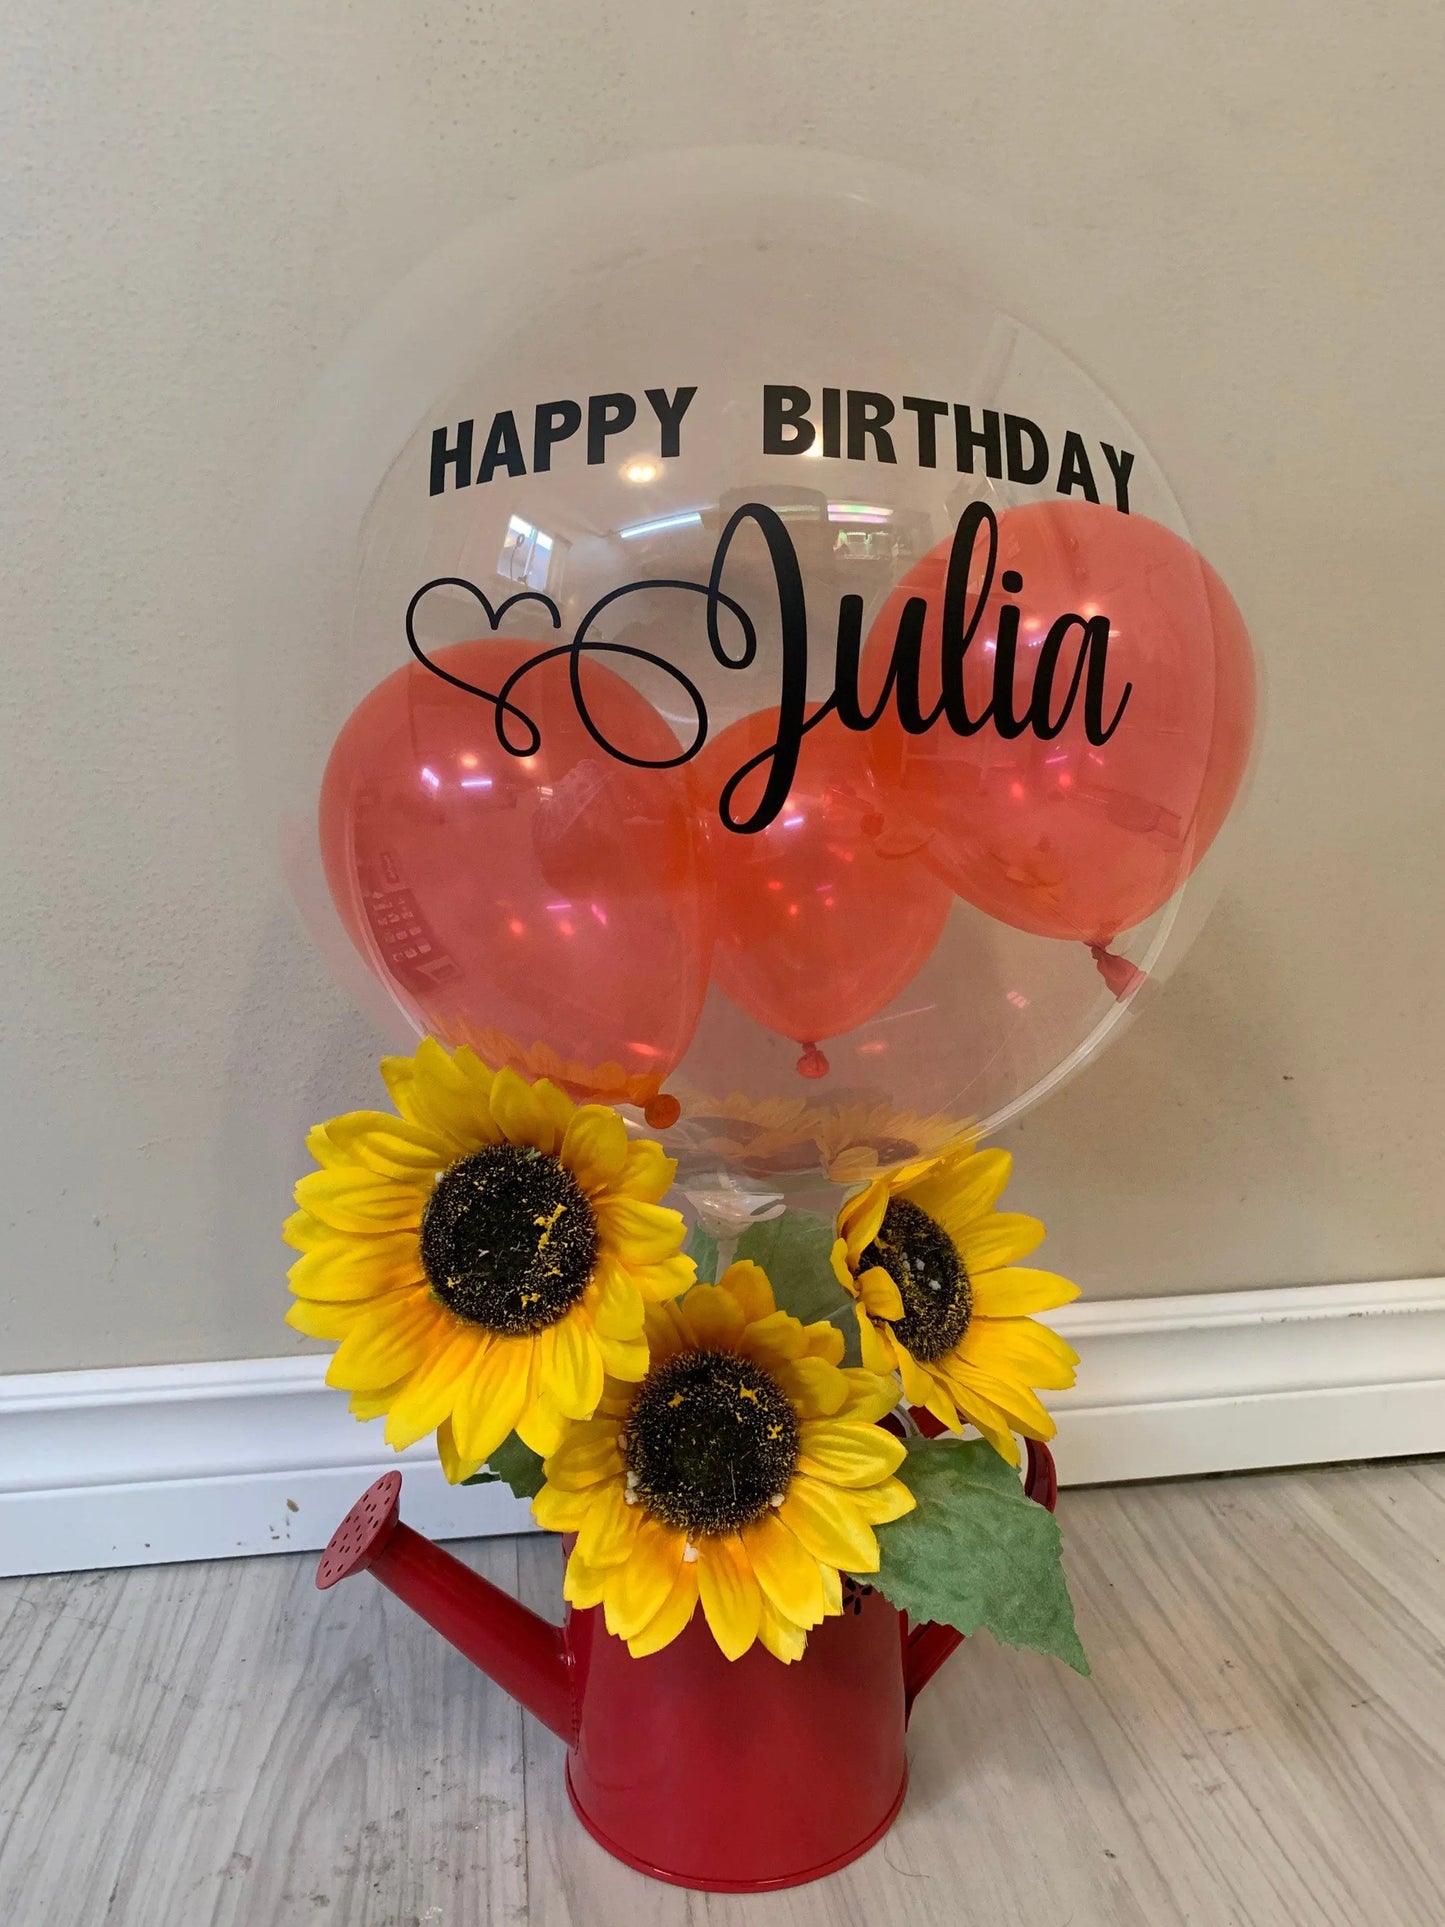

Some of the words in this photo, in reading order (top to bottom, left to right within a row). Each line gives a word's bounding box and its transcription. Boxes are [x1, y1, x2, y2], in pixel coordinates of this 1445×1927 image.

[429, 386, 698, 497] HAPPY
[763, 384, 1135, 515] BIRTHDAY
[704, 501, 1132, 835] Julia
